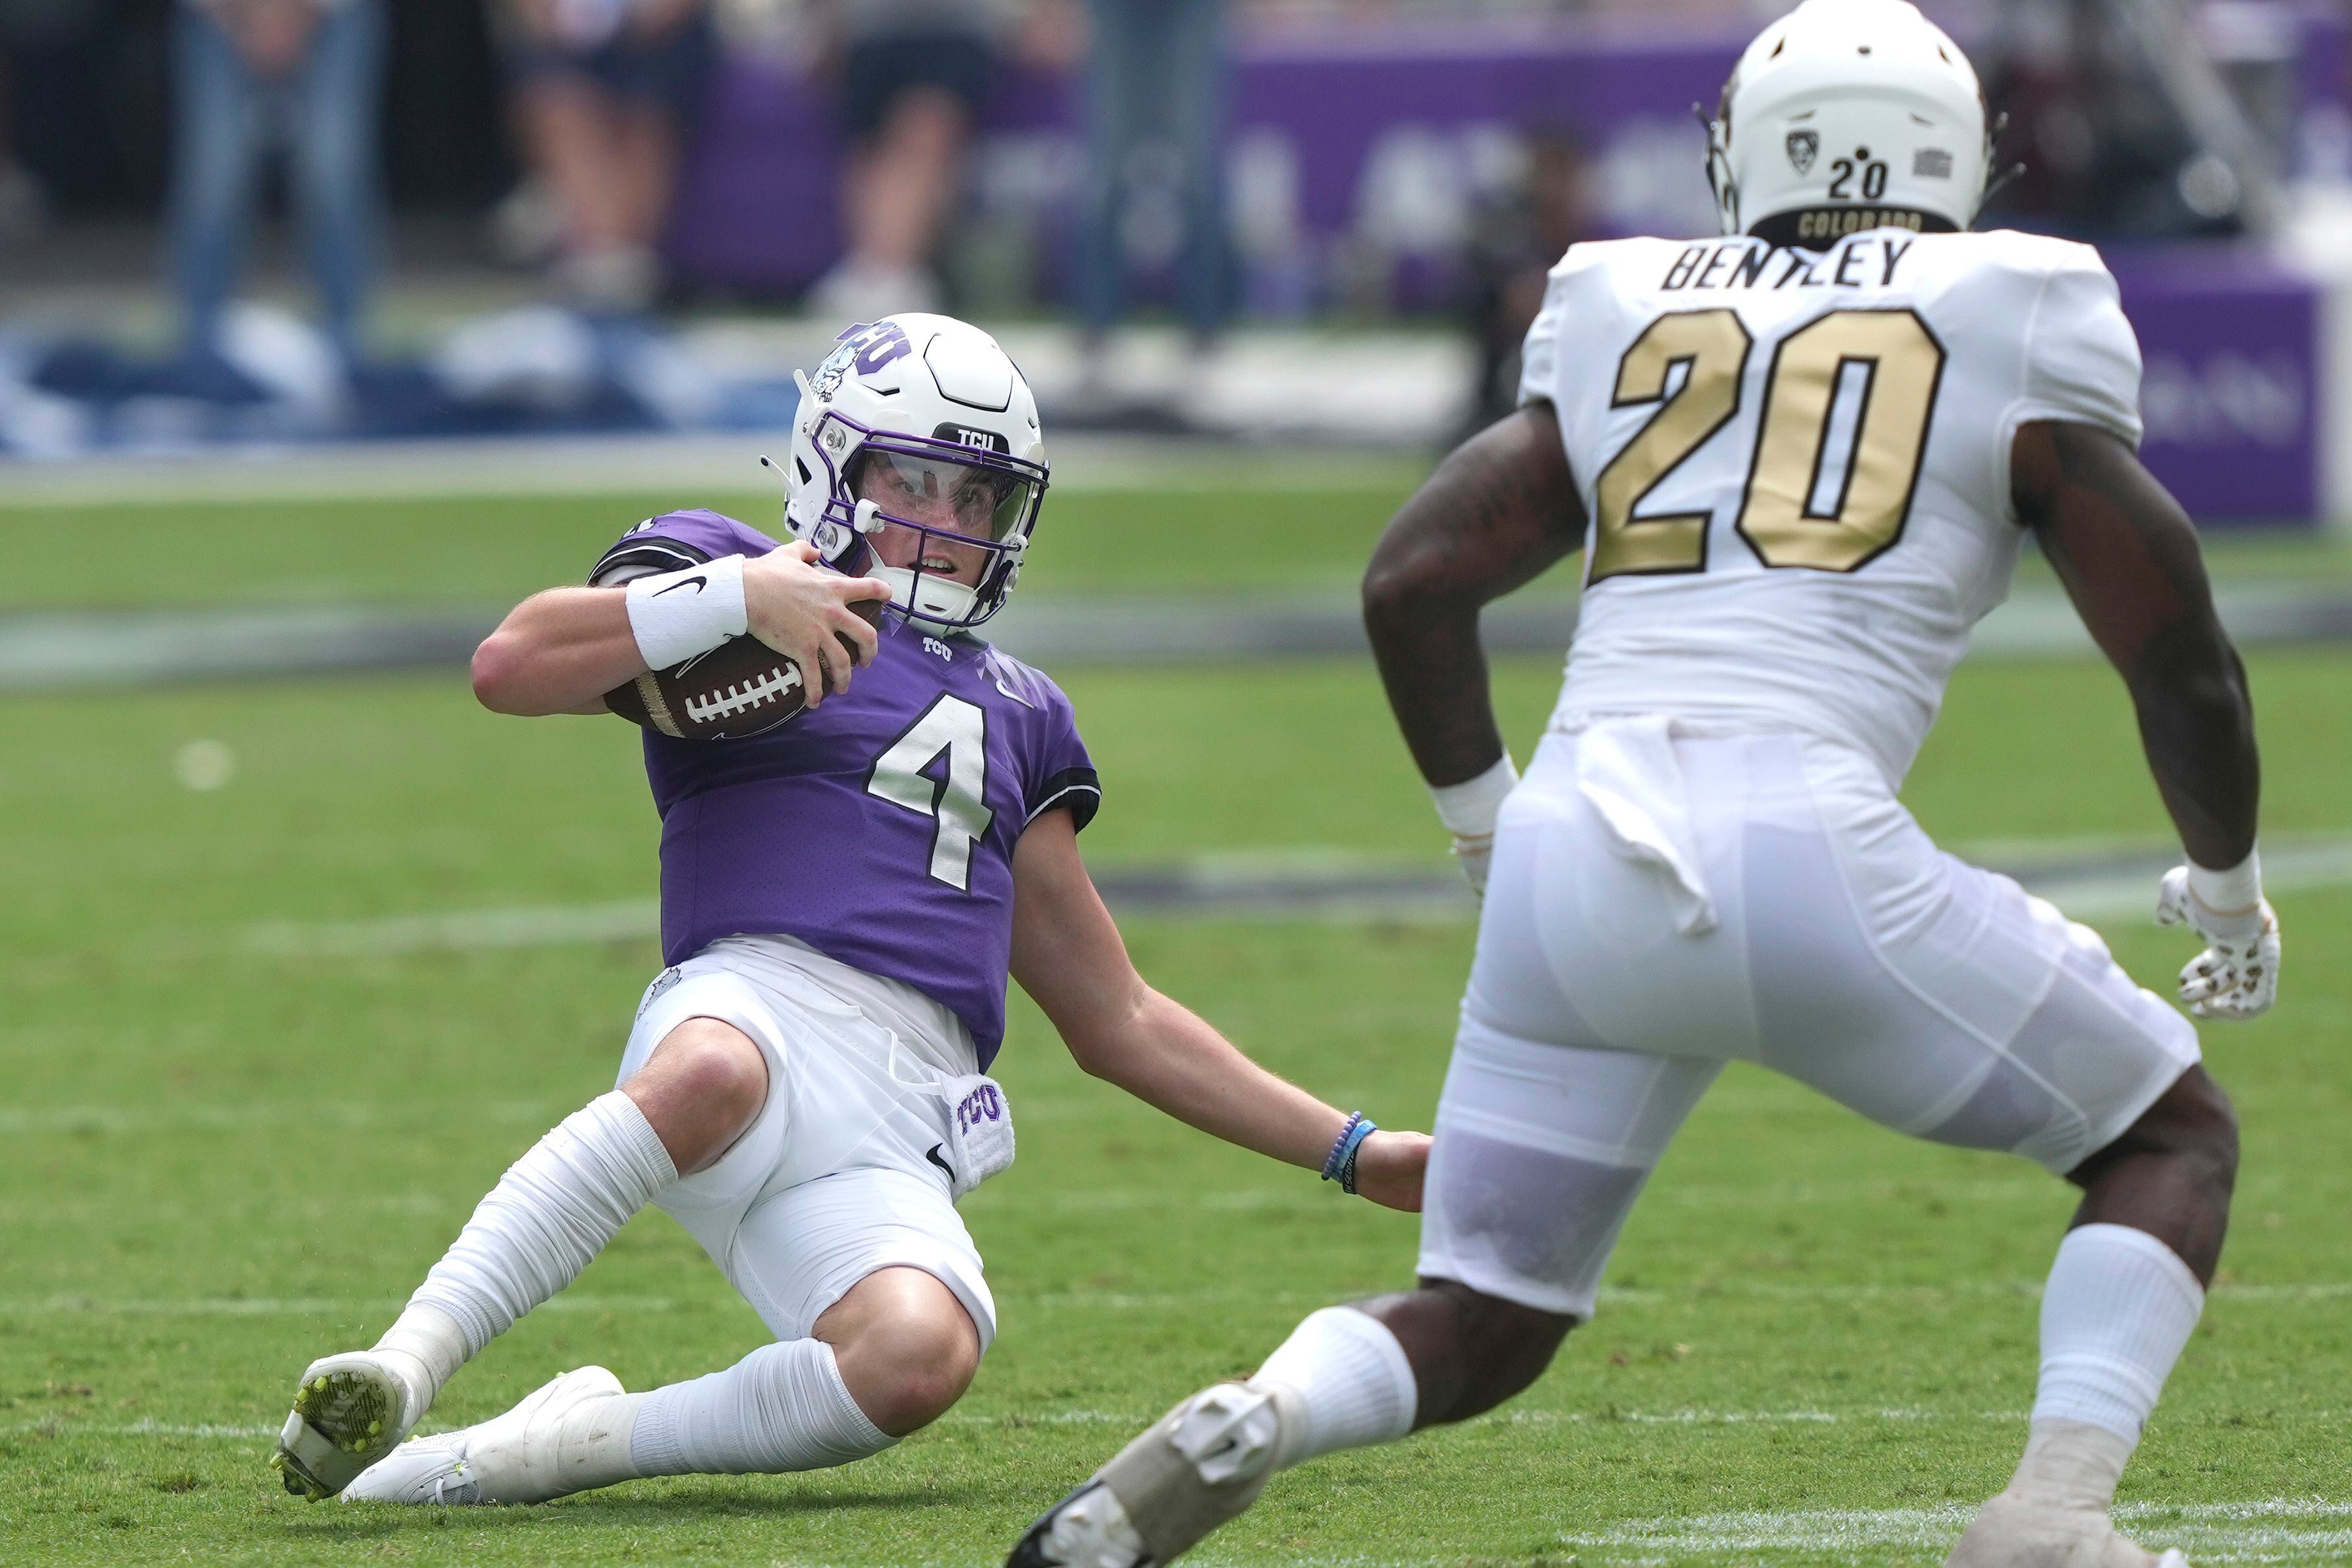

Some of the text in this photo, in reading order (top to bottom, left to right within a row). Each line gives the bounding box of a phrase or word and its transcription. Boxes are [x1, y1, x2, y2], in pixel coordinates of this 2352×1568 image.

[1829, 160, 1890, 200] 20
[1660, 238, 1914, 291] BENTLEY
[957, 428, 994, 451] TCU
[1586, 306, 1948, 588] 20
[923, 636, 953, 662] TCU
[862, 689, 996, 896] 4
[957, 1084, 1000, 1137] TCU
